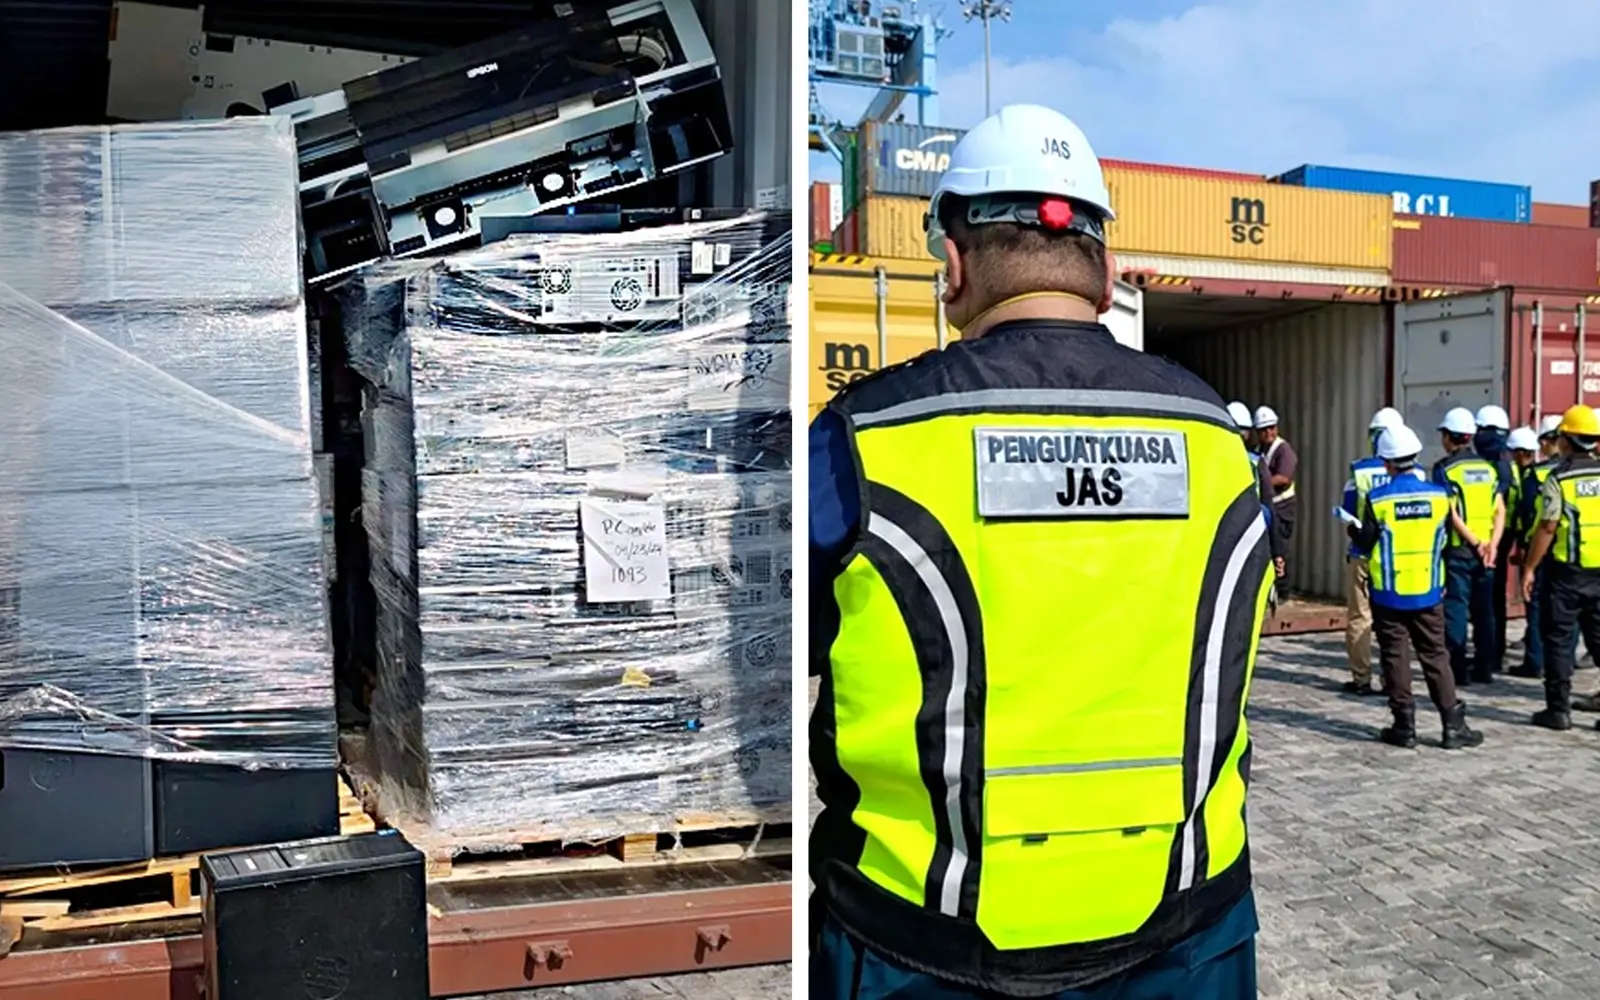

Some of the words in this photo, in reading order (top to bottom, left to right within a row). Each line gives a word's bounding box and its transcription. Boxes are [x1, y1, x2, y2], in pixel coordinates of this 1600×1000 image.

[1041, 137, 1071, 160] JAS
[987, 435, 1177, 465] PENGUATKUASA
[1056, 467, 1123, 507] JAS
[611, 566, 648, 585] 1093
